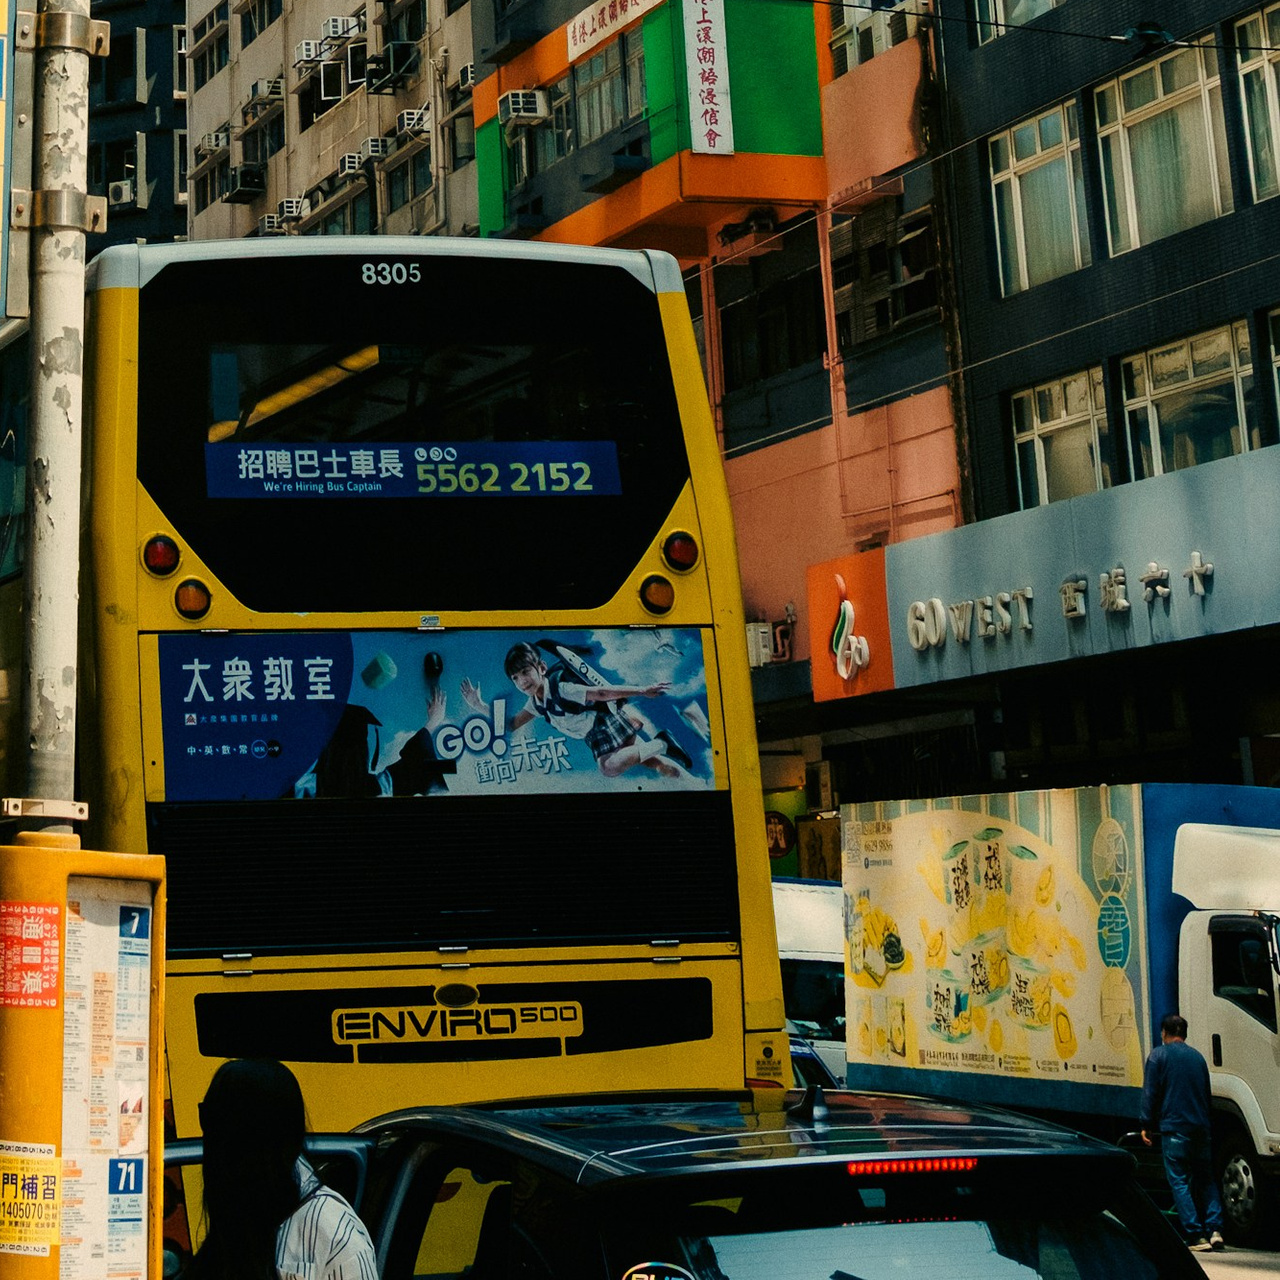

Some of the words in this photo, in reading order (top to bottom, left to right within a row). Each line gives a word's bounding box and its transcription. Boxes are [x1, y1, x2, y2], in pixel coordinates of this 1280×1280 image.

[361, 263, 422, 285] 8305
[238, 448, 404, 479] 招聘巴士車長
[417, 463, 501, 493] 5562
[510, 462, 593, 492] 2152
[263, 480, 293, 492] We're
[295, 480, 324, 494] Hiring
[327, 480, 344, 492] Bus
[347, 480, 382, 494] Captain
[435, 698, 507, 760] GO!
[131, 912, 140, 935] 7
[336, 1005, 577, 1040] ENVIRO500
[118, 1162, 136, 1191] 71
